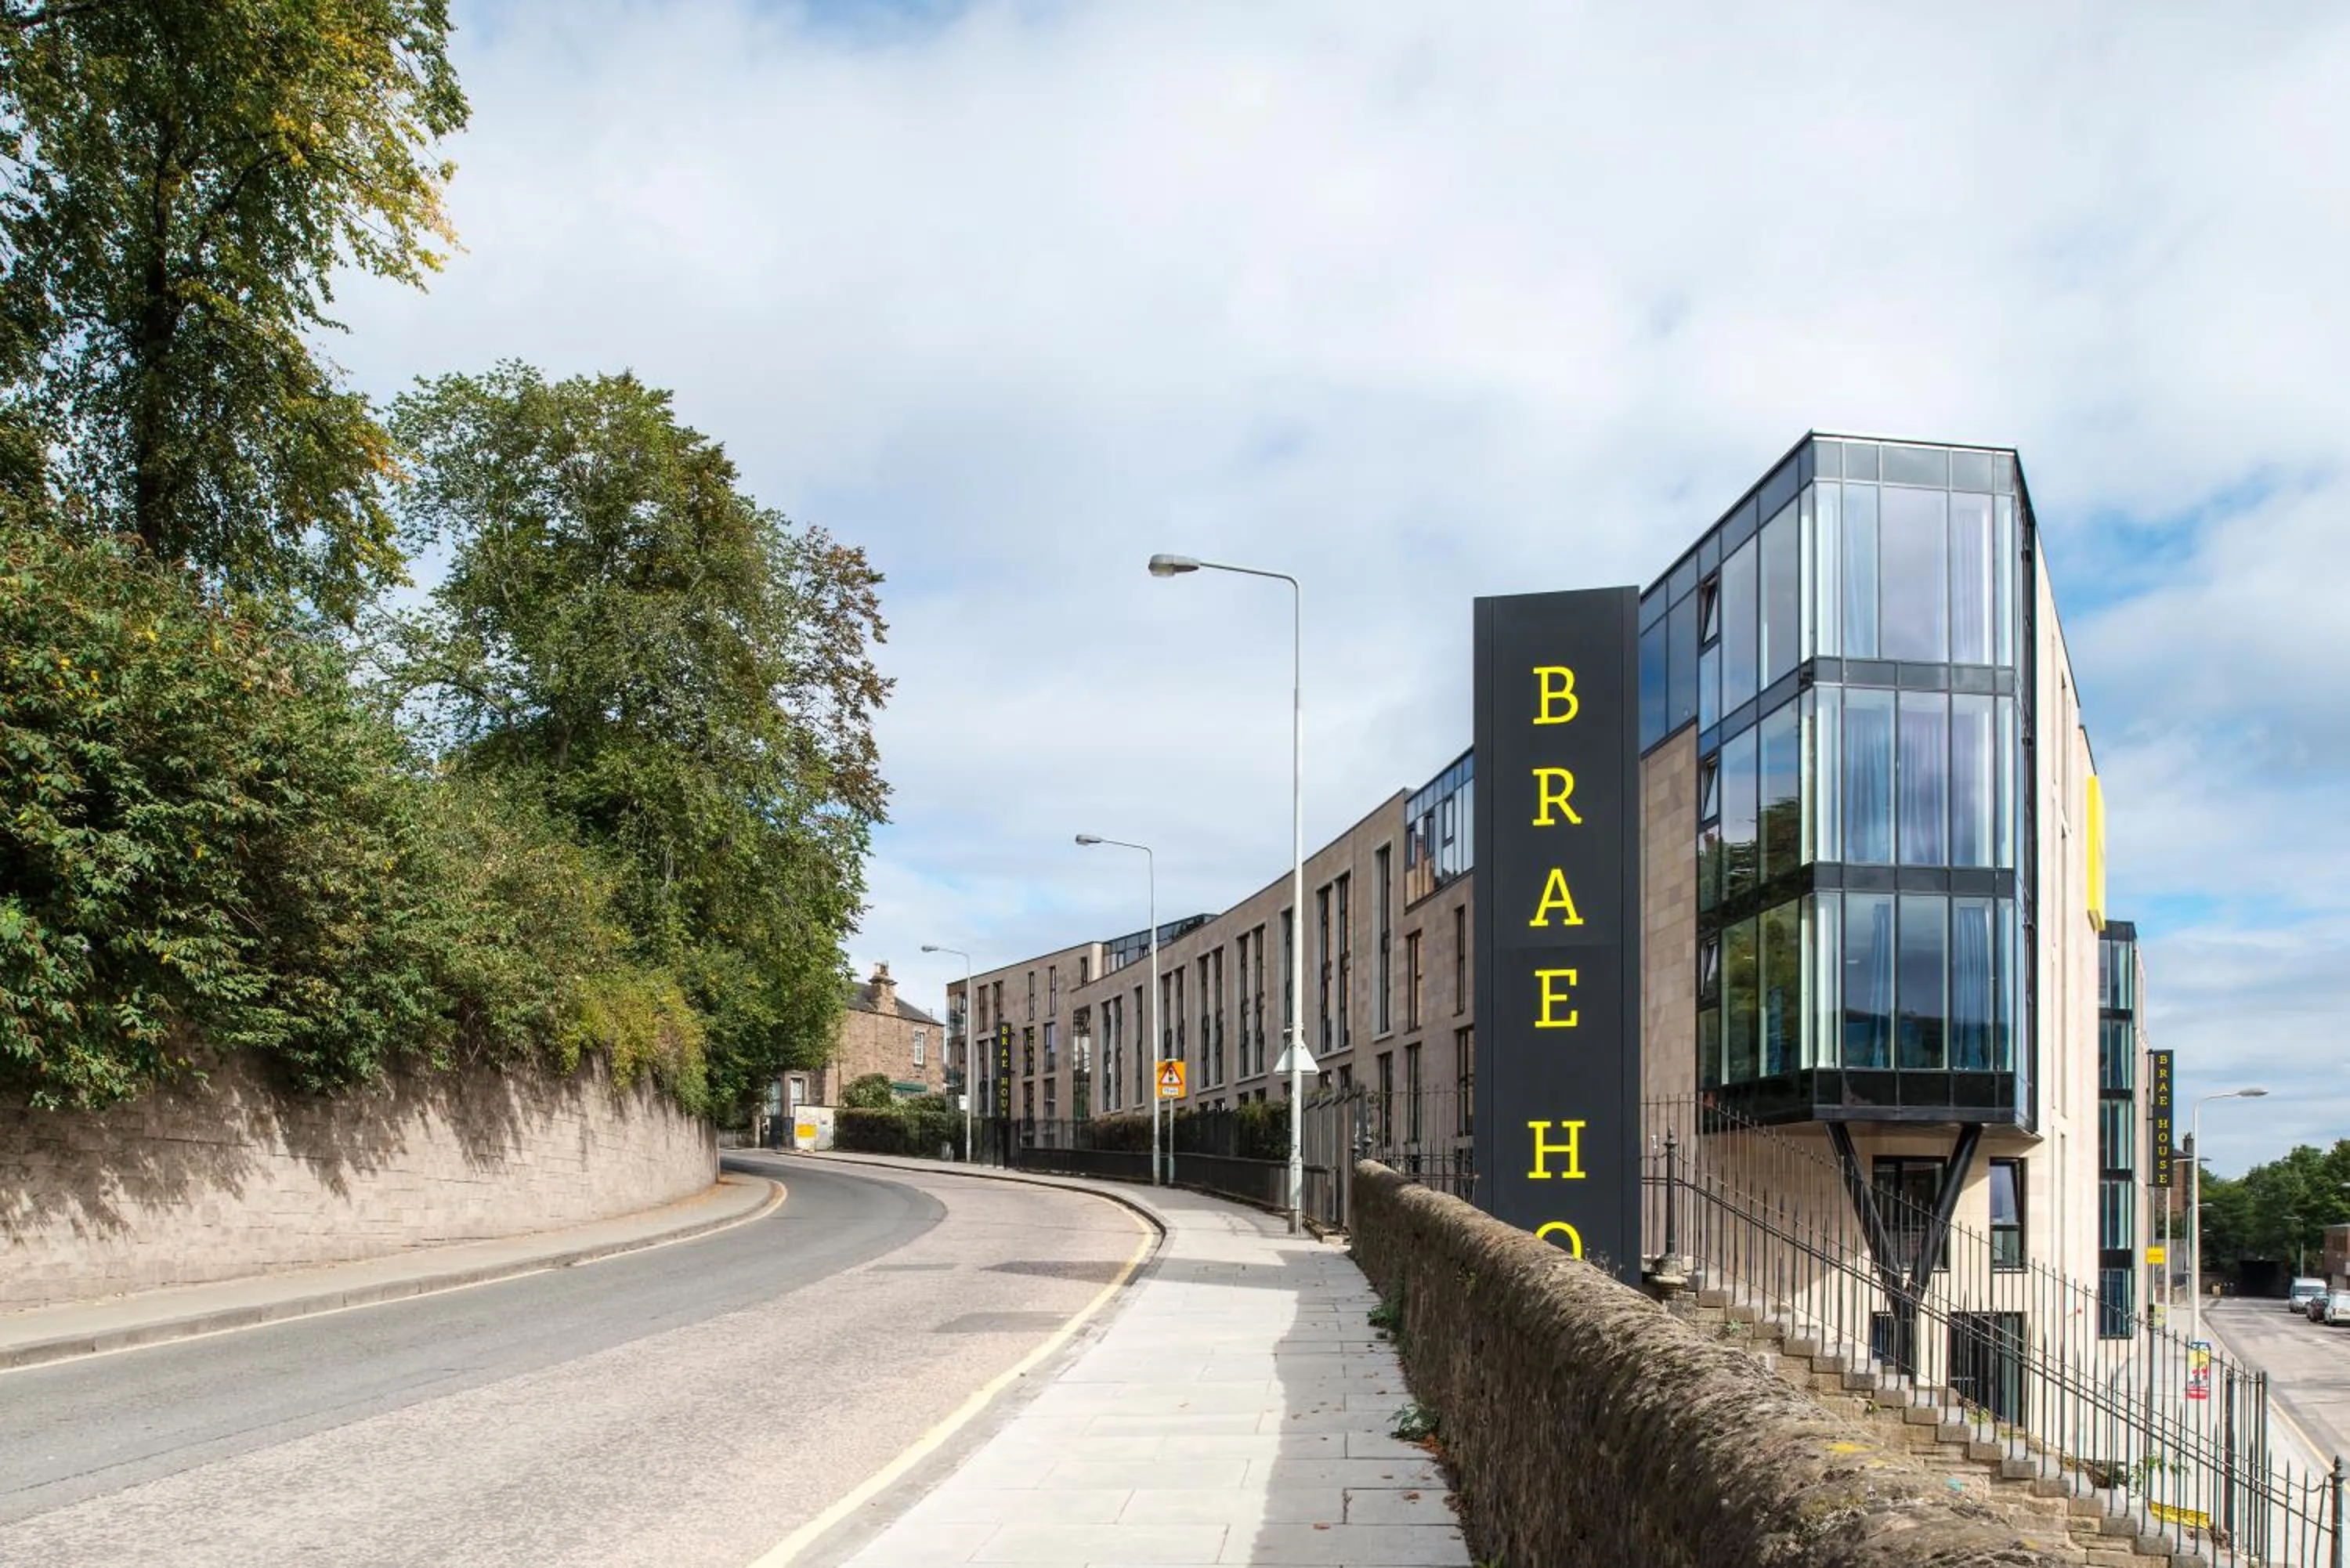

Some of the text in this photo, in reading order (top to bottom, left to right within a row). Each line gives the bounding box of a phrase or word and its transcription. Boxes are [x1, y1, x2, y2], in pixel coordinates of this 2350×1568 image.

[1529, 666, 1584, 1028] BRAE
[2158, 1055, 2168, 1183] BRAE HOUSE
